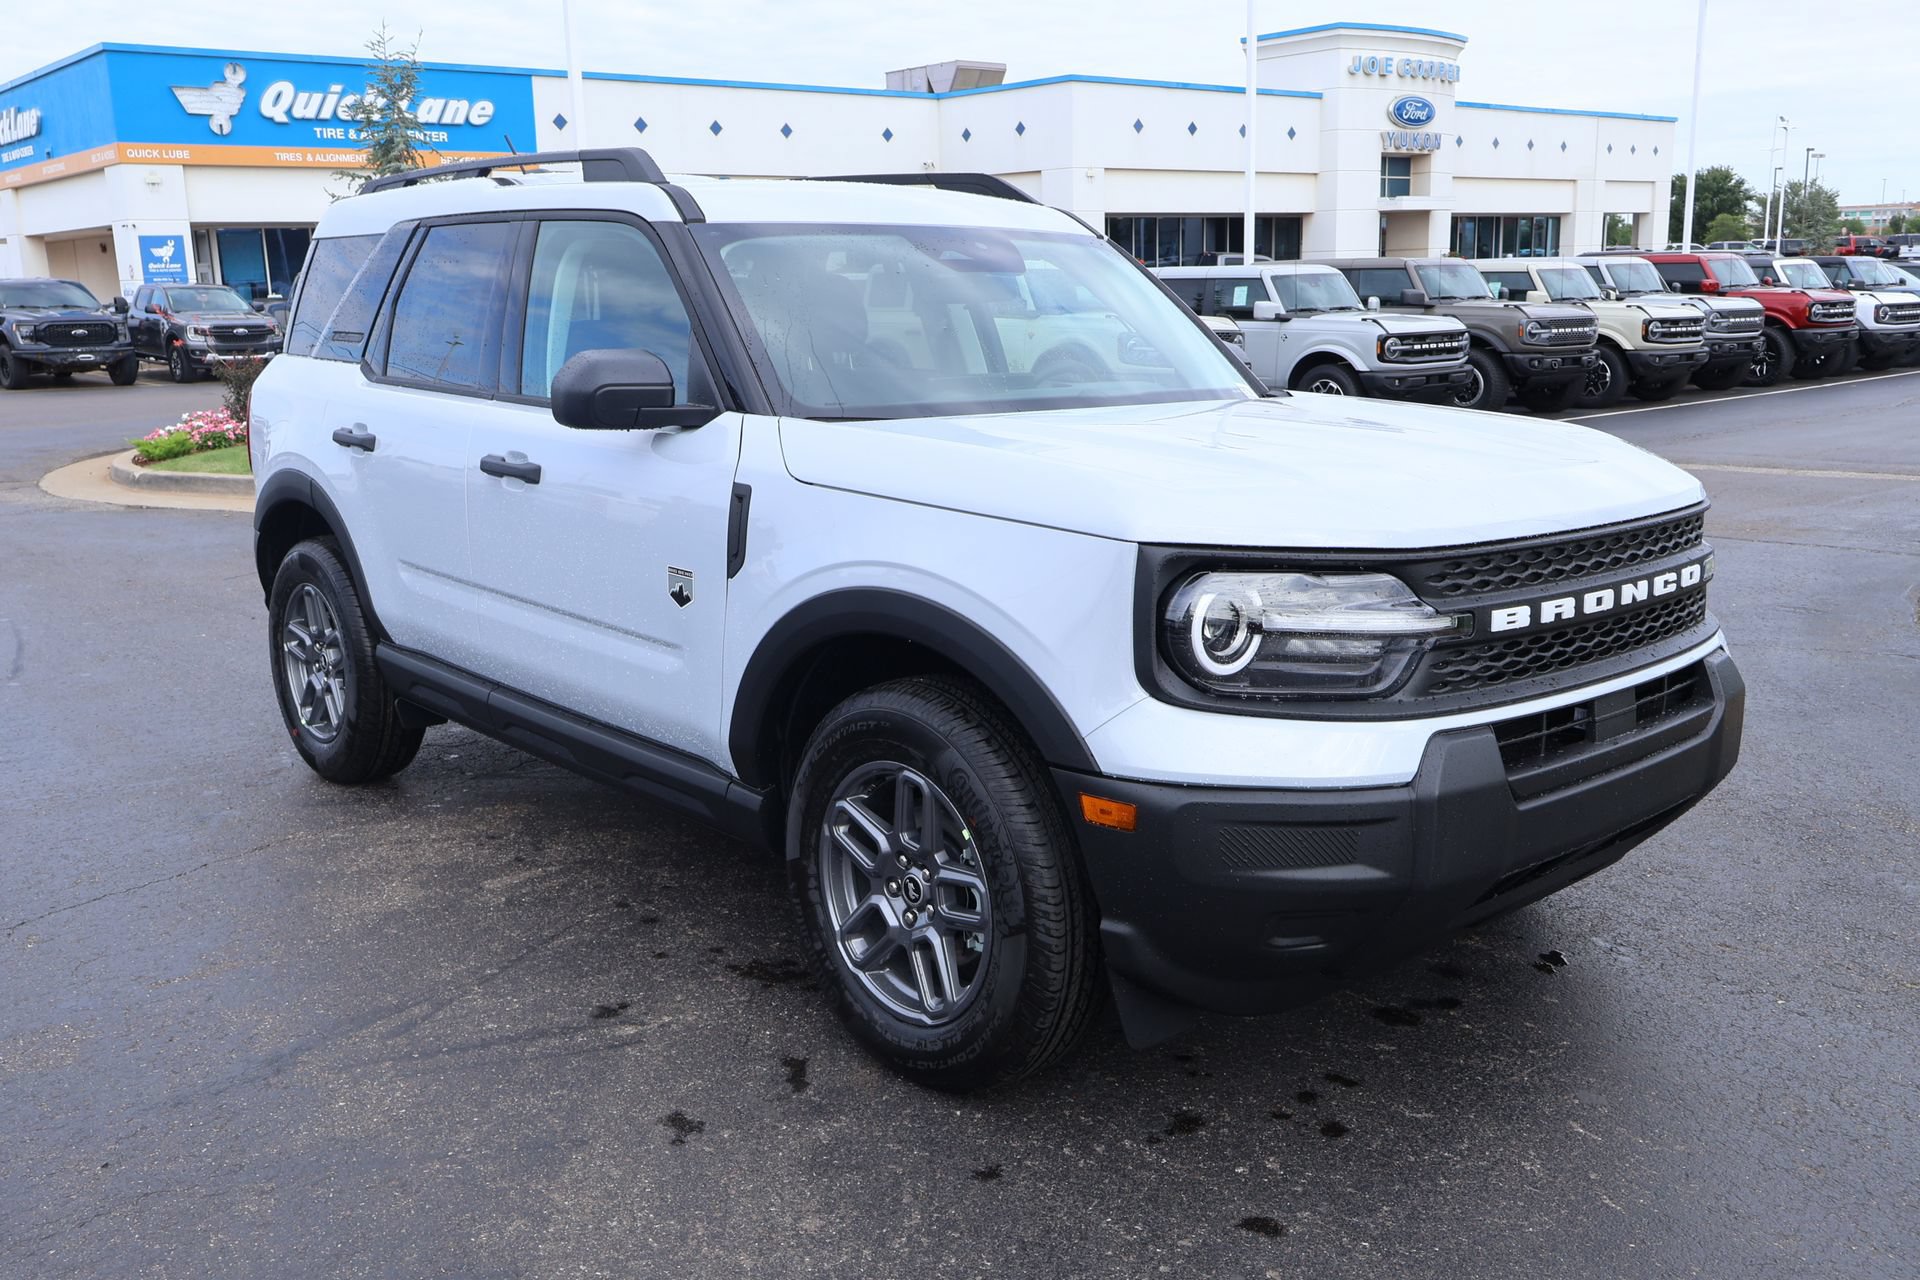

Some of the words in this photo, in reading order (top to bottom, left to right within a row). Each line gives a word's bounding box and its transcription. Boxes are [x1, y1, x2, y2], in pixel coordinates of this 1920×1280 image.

[1350, 56, 1393, 75] JOE
[1399, 58, 1460, 82] COOPER
[259, 80, 388, 124] Quick
[1403, 101, 1428, 120] Ford
[313, 127, 345, 139] TIRE
[348, 128, 357, 139] &
[1384, 132, 1441, 150] YUKON
[126, 149, 160, 158] QUICK
[162, 149, 191, 159] LUBE
[274, 152, 303, 161] TIRES
[306, 152, 314, 162] &
[1413, 341, 1458, 349] BRONCO
[1490, 564, 1701, 633] BRONCO
